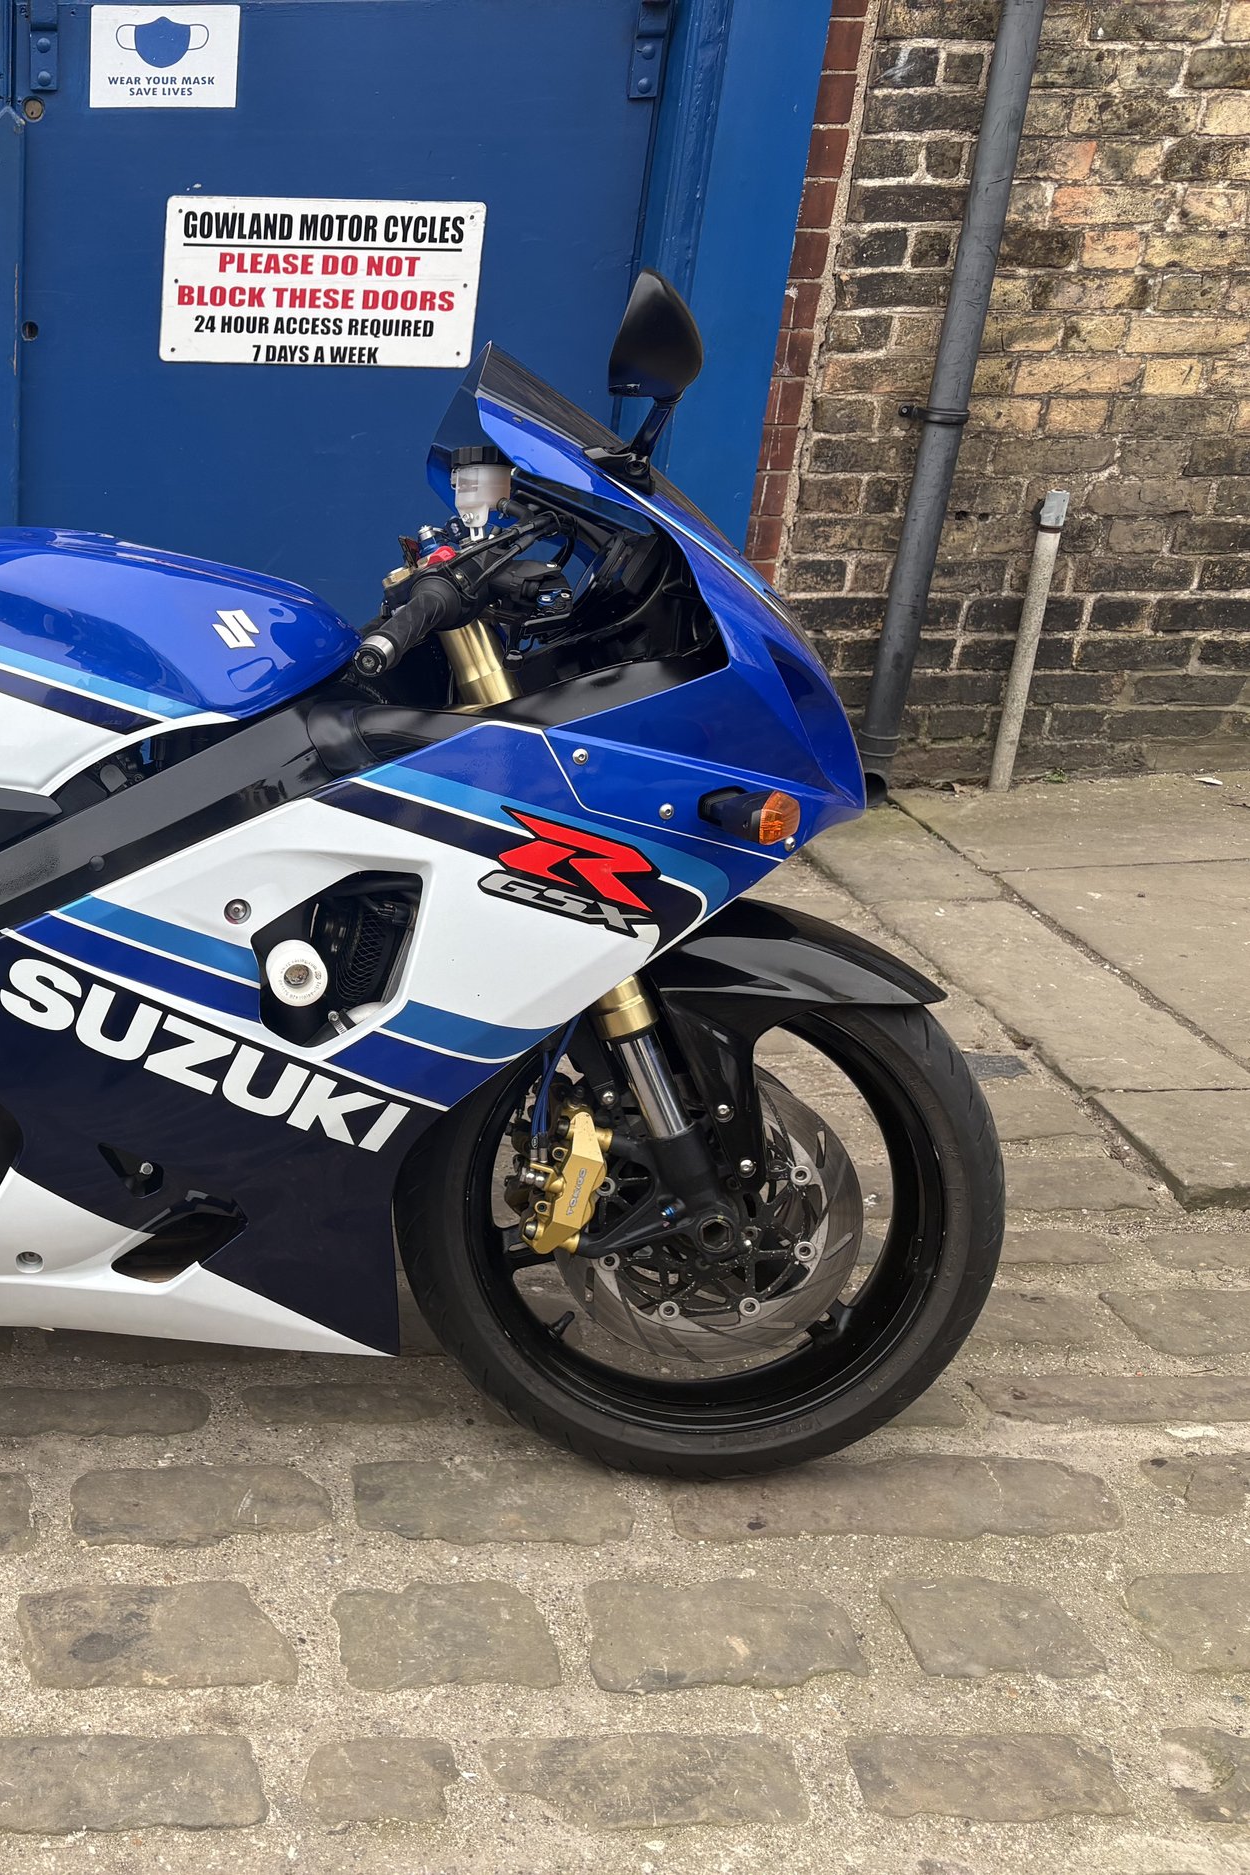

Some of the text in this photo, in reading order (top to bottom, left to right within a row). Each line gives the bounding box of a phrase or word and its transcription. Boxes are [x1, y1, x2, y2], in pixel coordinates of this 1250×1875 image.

[107, 76, 215, 85] WEAR YOUR MASK
[129, 87, 193, 96] SAVE LIVES
[183, 210, 465, 244] GOWLAND MOTOR CYCLES
[218, 252, 421, 277] PLEASE DO NOT
[177, 285, 455, 313] BLOCK THESE DOORS
[194, 314, 434, 338] 24 HOUR ACCESS REQUIRED
[252, 344, 379, 365] 7 DAYS A WEEK
[0, 958, 411, 1153] SUZUKI
